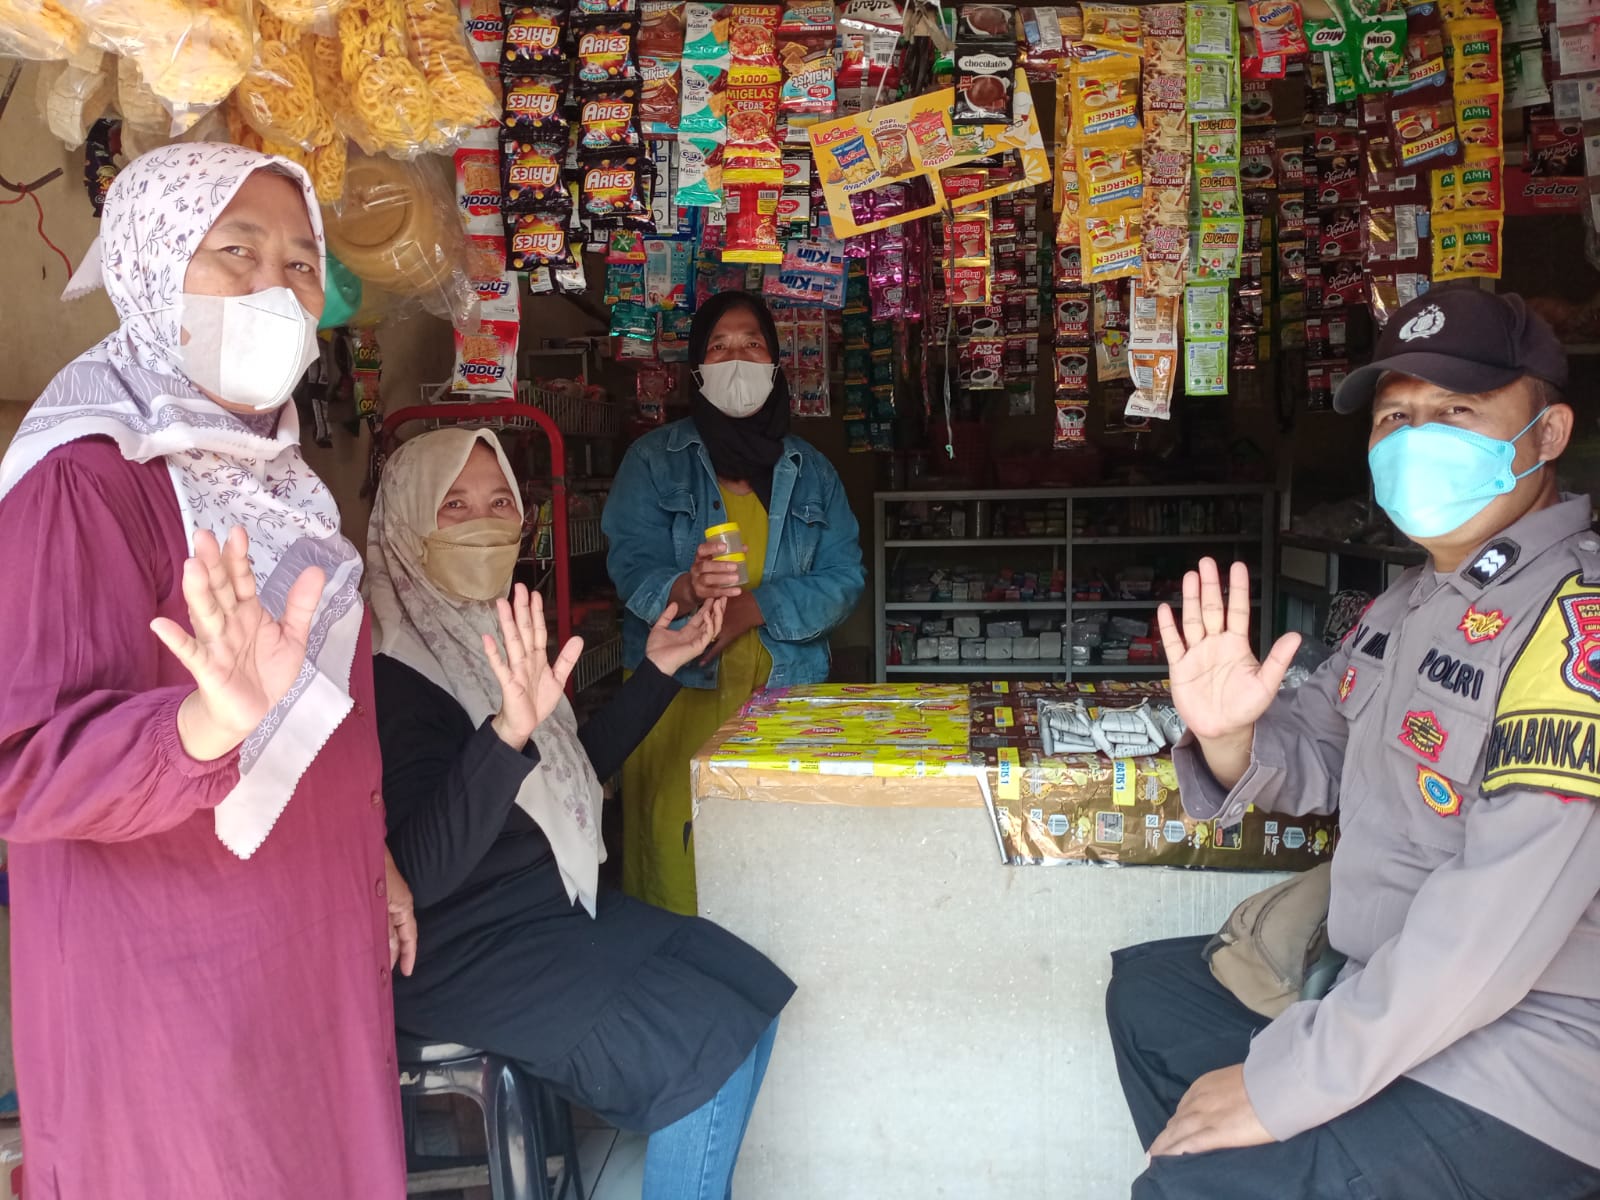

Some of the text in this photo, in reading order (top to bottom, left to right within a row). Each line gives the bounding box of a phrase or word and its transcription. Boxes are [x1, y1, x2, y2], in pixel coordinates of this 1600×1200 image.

[465, 20, 504, 32] naak
[508, 26, 557, 47] ARIES
[580, 35, 628, 54] ARIES
[1316, 30, 1344, 42] MILO
[1367, 36, 1392, 45] MILO
[1464, 42, 1490, 54] AMH
[791, 68, 832, 88] Malkist
[1410, 63, 1441, 81] ENERG
[727, 88, 775, 99] MIGELAS
[508, 94, 556, 114] ARIES
[583, 103, 631, 121] ARIES
[1464, 106, 1491, 118] AMH
[1088, 104, 1136, 123] ENERGEN
[1406, 131, 1453, 155] ENERGEN
[511, 166, 557, 186] ARIES
[586, 171, 633, 189] ARIES
[1094, 176, 1139, 193] ENERGEN
[1464, 170, 1491, 182] AMH
[460, 194, 502, 209] naak
[515, 232, 562, 253] ARIES
[1465, 233, 1491, 244] AMH
[797, 248, 830, 263] Klin
[1096, 247, 1142, 264] ENERGEN
[779, 274, 812, 290] Klin
[973, 344, 1002, 355] ABC
[459, 363, 505, 379] Enaak
[1418, 648, 1484, 701] POLRI
[1488, 717, 1600, 774] HABINKA
